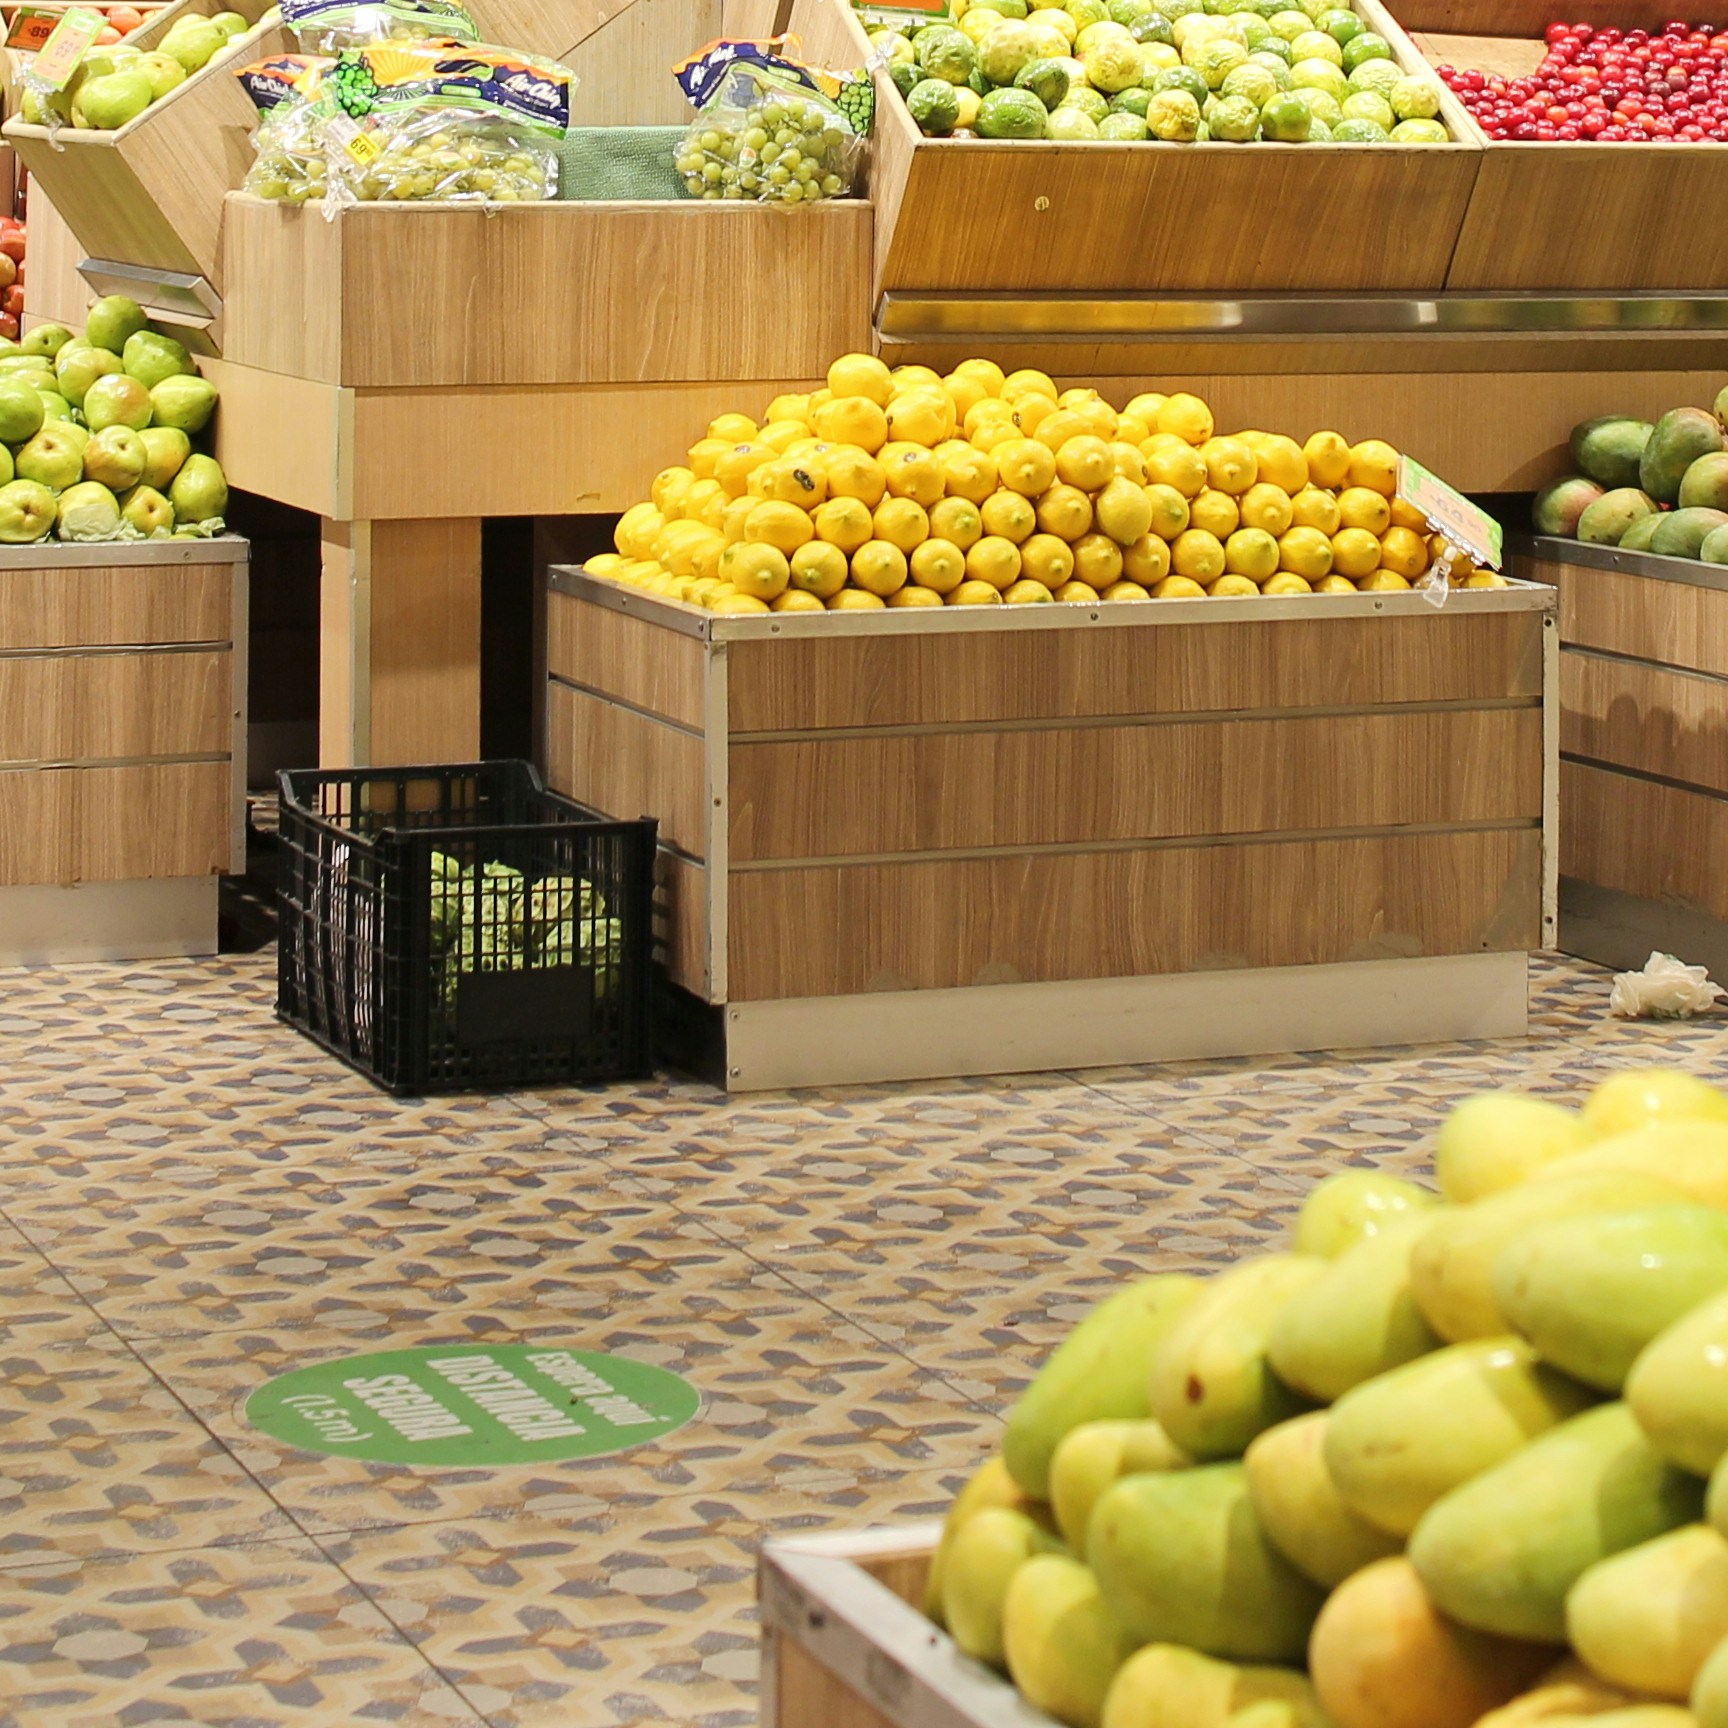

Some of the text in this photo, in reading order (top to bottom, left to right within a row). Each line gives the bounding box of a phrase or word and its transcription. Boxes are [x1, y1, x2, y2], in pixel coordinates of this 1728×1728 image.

[342, 1374, 474, 1442] SEGURA
[426, 1354, 587, 1442] DISTANCIA
[525, 1351, 671, 1426] Espera aquí
